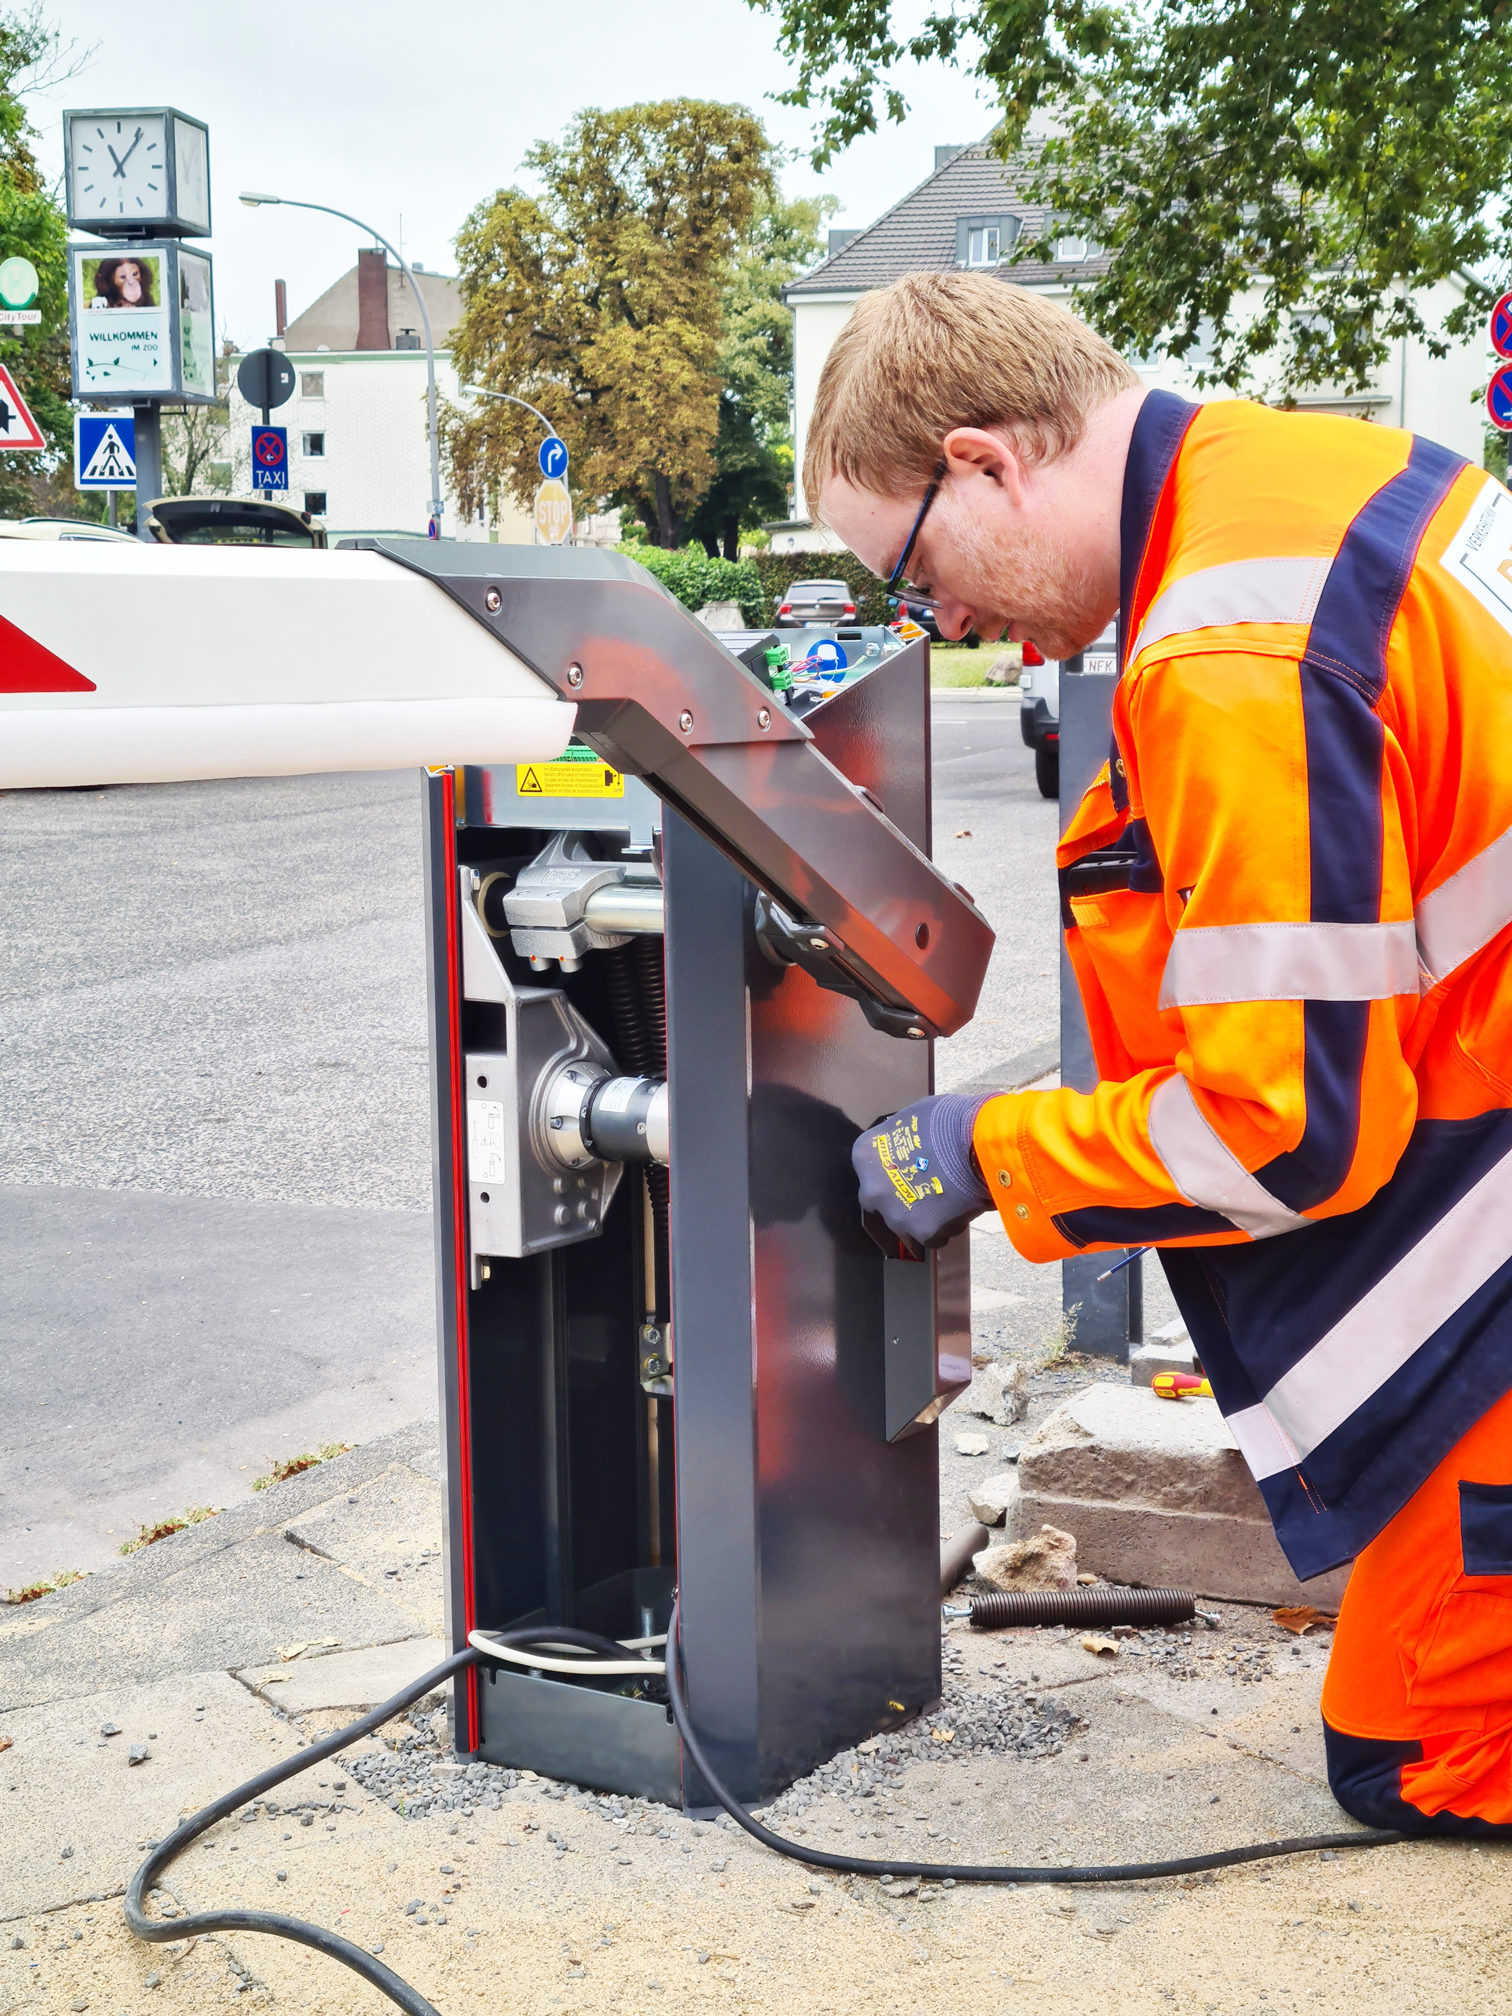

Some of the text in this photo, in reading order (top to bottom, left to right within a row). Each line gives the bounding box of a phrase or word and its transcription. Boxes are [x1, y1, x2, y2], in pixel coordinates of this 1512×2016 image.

[7, 269, 27, 298] H
[89, 331, 158, 342] WILLKOMMEN
[255, 470, 286, 485] TAXI
[538, 500, 568, 525] STOP
